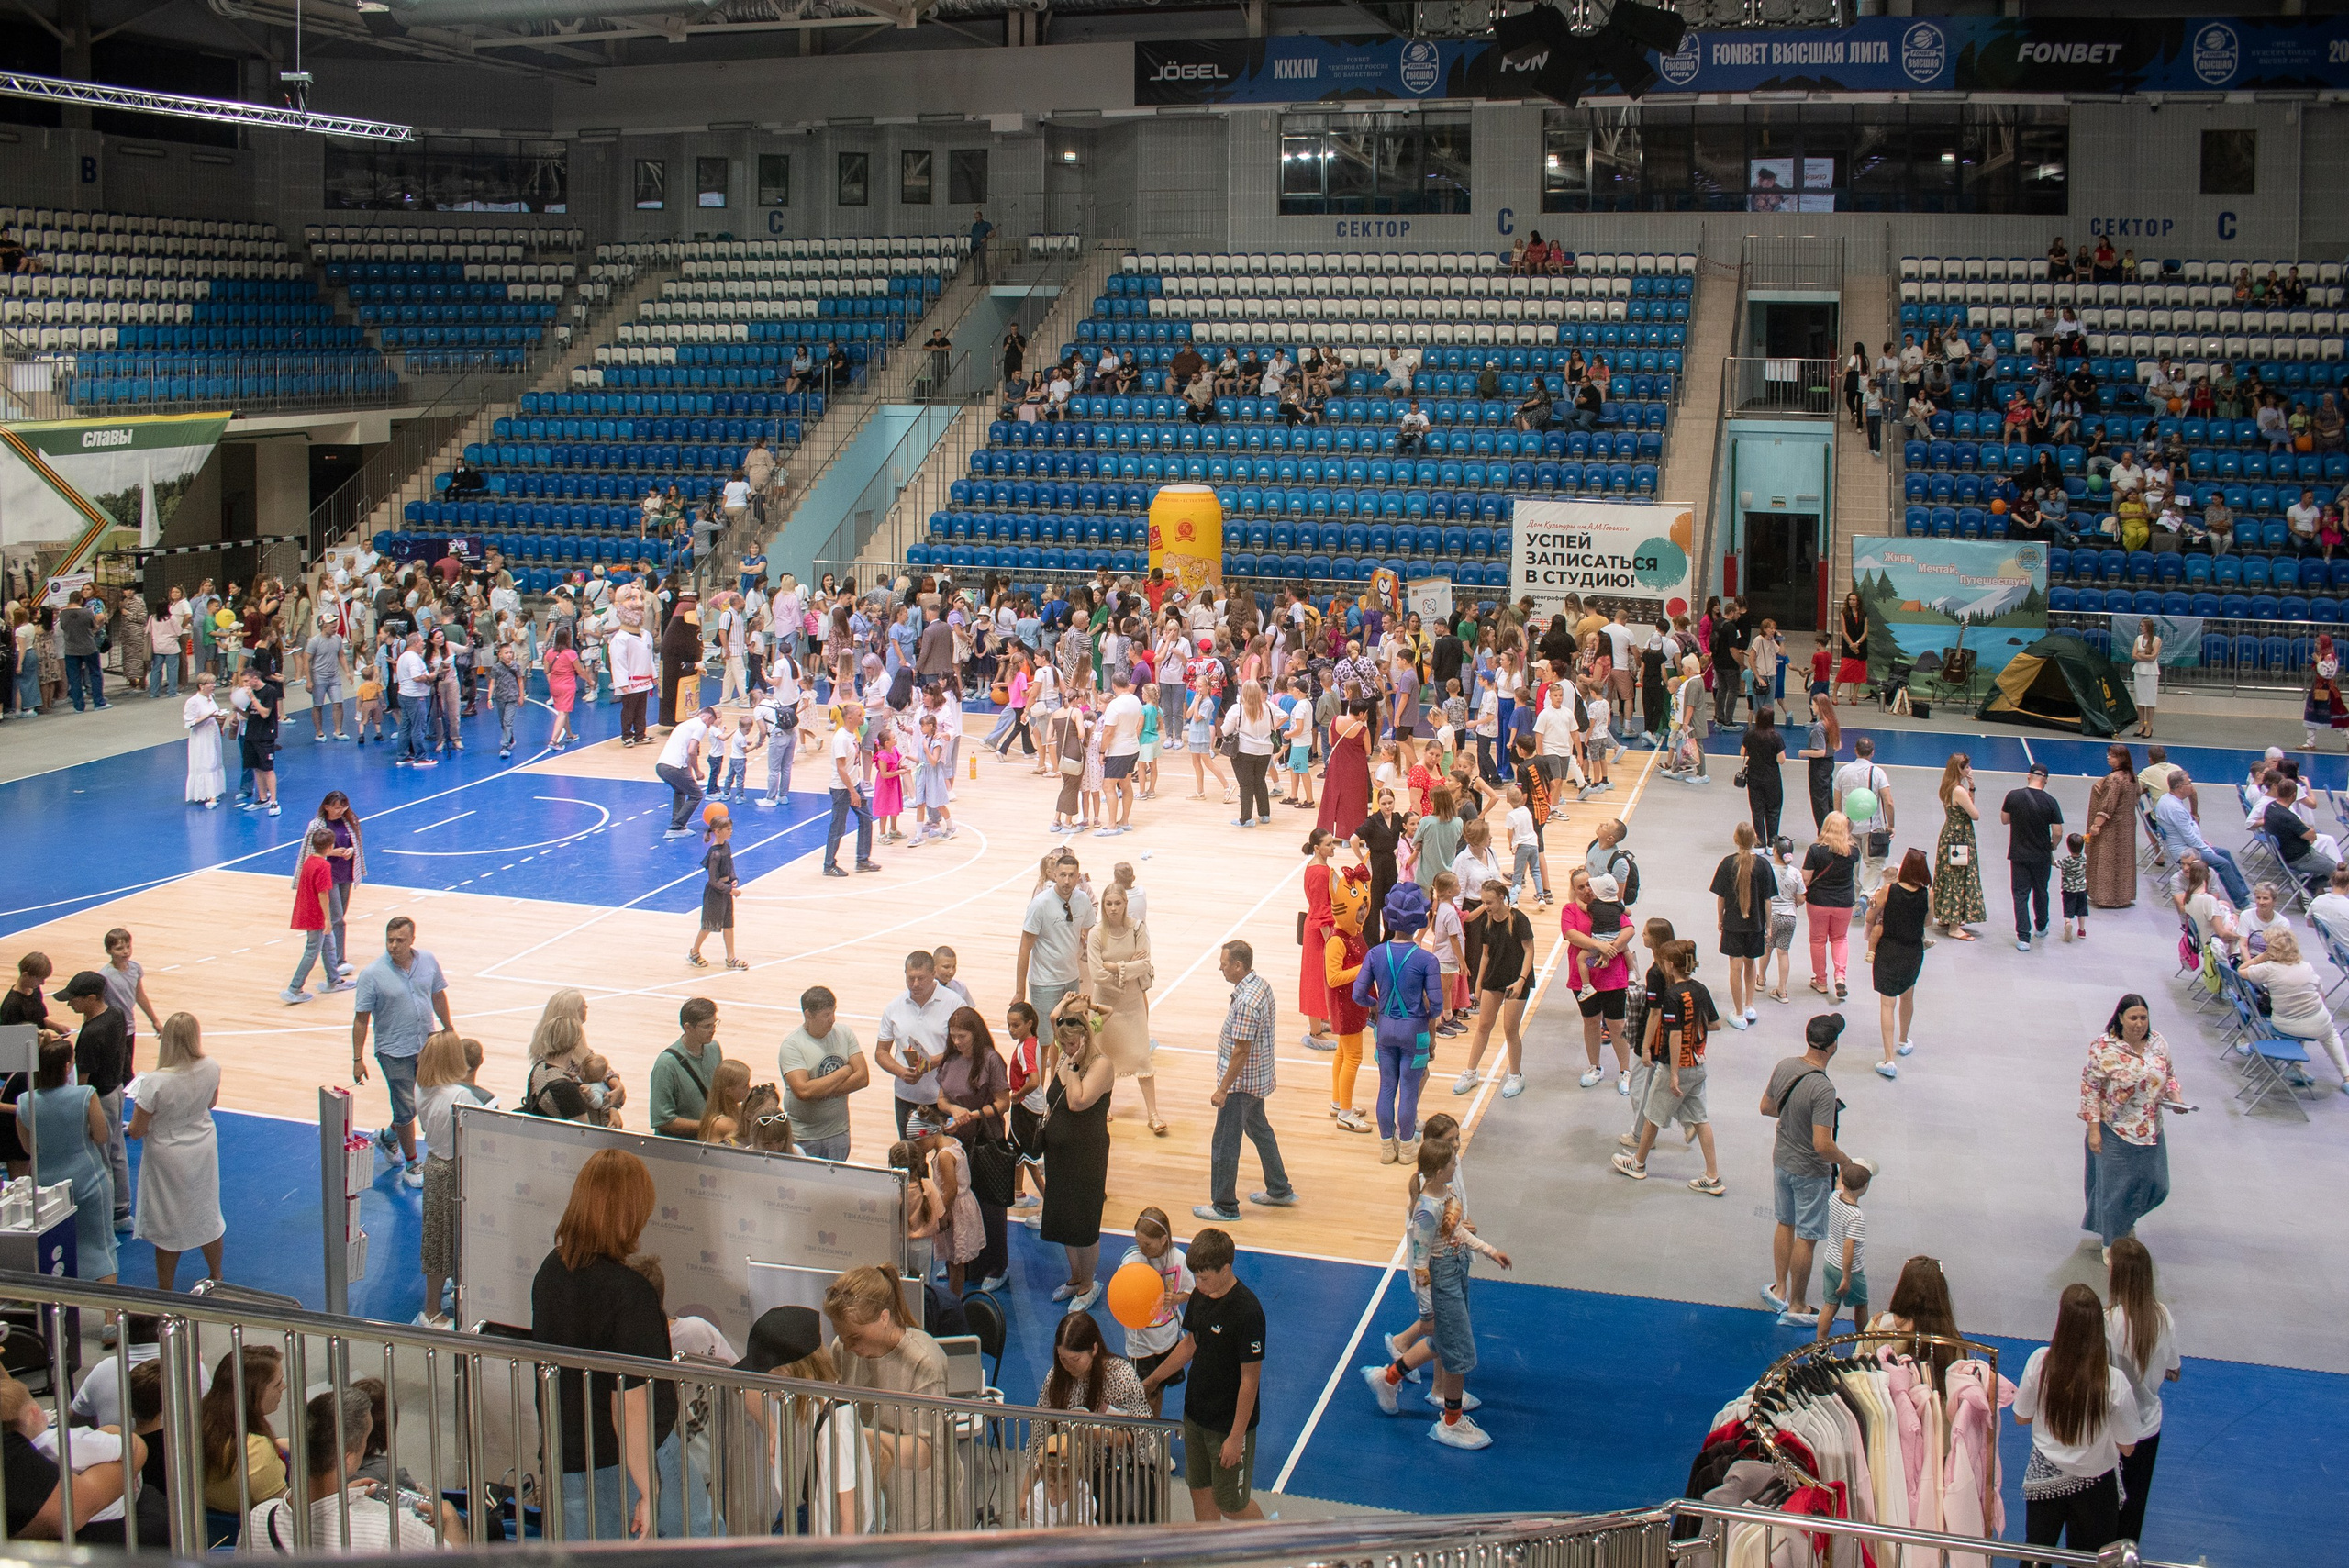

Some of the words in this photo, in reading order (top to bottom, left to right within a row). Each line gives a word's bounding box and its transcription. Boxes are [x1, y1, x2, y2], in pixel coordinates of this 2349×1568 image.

[1712, 43, 1768, 65] FONBET
[1772, 41, 1844, 64] ВЫСШАЯ
[1848, 41, 1889, 64] ЛИГА
[2017, 42, 2122, 64] FONBET
[1150, 61, 1229, 81] JÖGEL
[1274, 58, 1319, 80] XXXIV
[1664, 60, 1695, 71] ВЫСШАЯ
[1908, 58, 1939, 69] ВЫСШАЯ
[1406, 70, 1434, 80] ВЫСШАЯ
[1336, 220, 1411, 239] СЕКТОР
[2090, 217, 2174, 238] СЕКТОР
[83, 428, 134, 448] славы
[1526, 519, 1542, 529] Дом
[1543, 520, 1575, 531] Культуры
[1526, 532, 1592, 550] УСПЕЙ
[1525, 550, 1658, 571] ЗАПИСАТЬСЯ
[1883, 551, 1915, 564] Живи,
[1525, 569, 1538, 584] В
[1542, 570, 1635, 589] СТУДИЮ!
[1917, 562, 1959, 576] Мечтай,
[1959, 574, 2031, 587] Путешествуй!
[1527, 763, 1541, 786] TEAM
[1681, 991, 1695, 1021] TEAM
